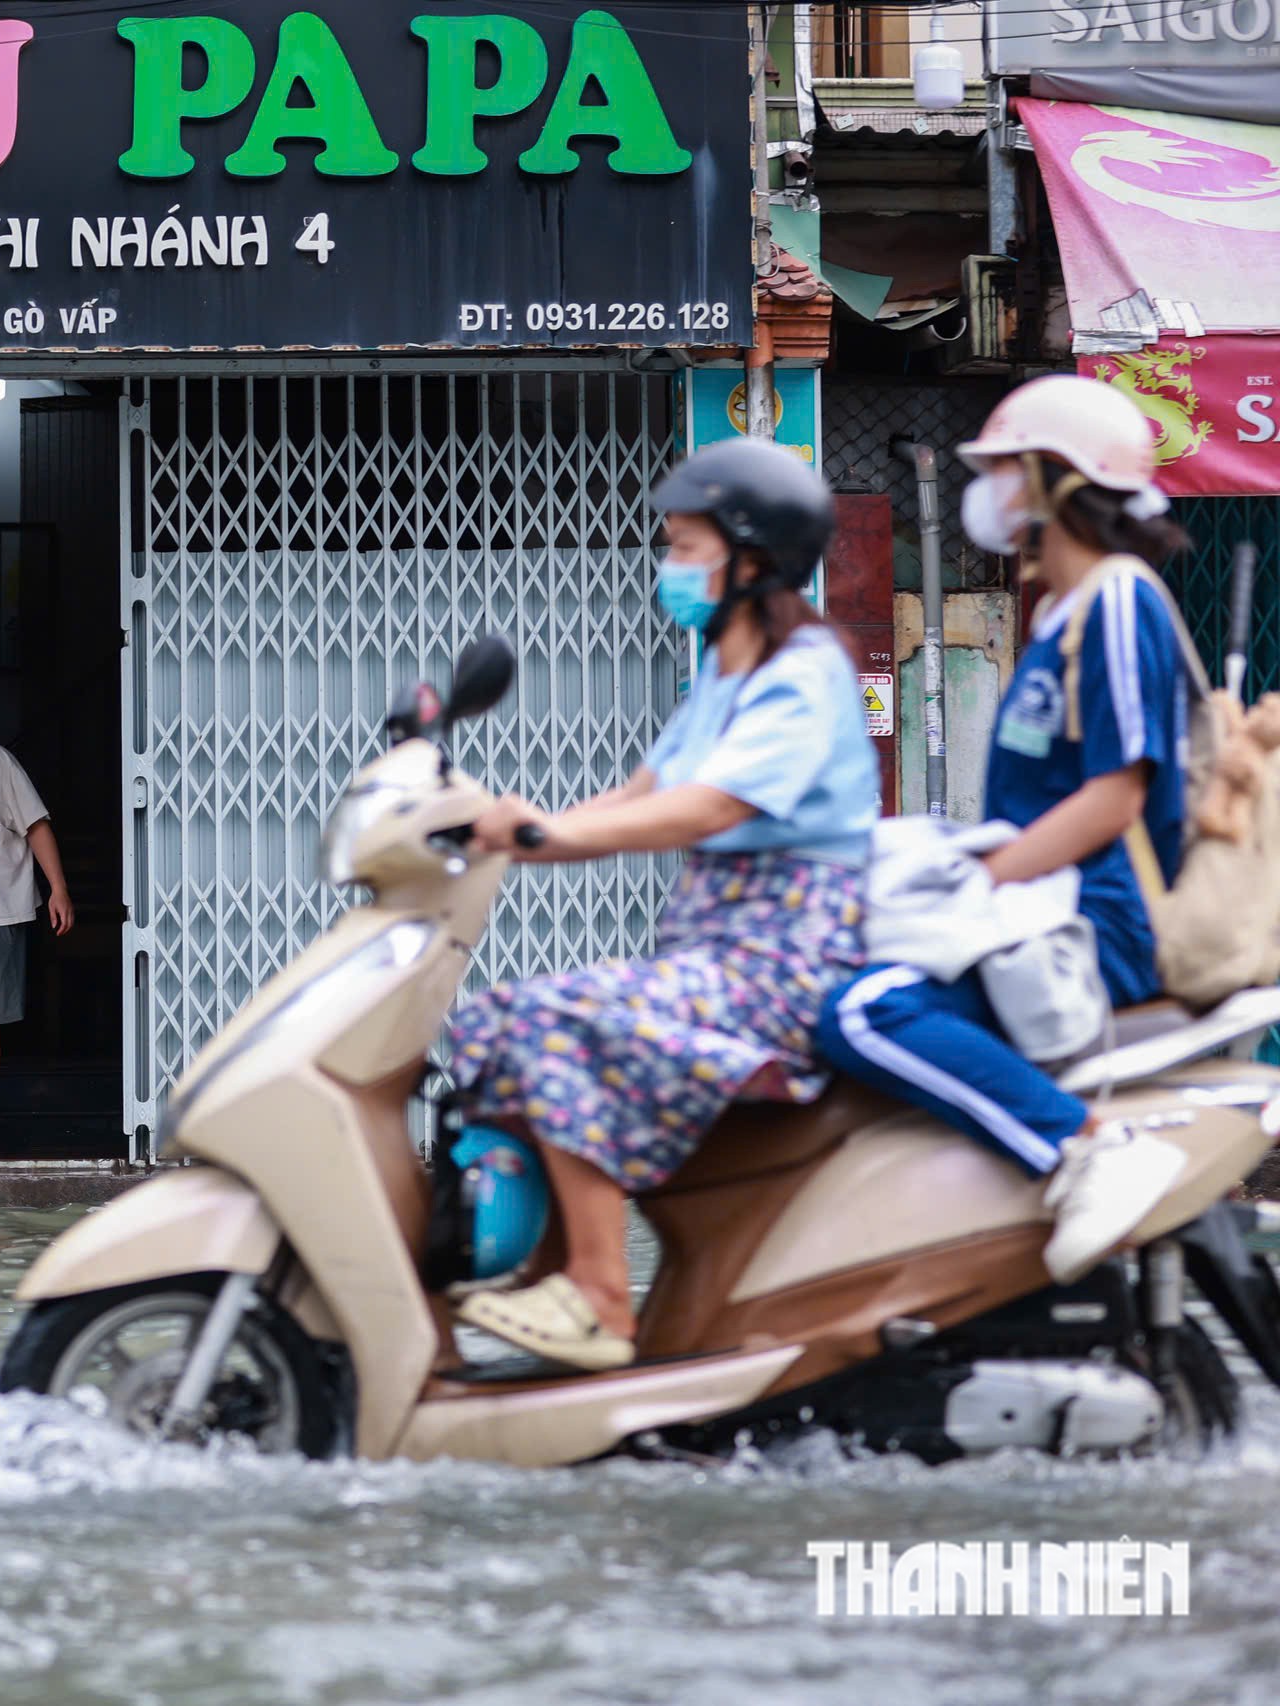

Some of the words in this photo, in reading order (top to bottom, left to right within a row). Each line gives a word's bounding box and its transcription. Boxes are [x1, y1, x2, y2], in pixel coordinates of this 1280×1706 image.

[1050, 0, 1280, 42] SAIGO
[117, 10, 693, 178] PAPA
[71, 204, 269, 267] NHÁNH
[295, 212, 336, 264] 4
[3, 300, 45, 334] GÒ
[59, 298, 118, 334] VẤP
[459, 304, 512, 331] ĐT:
[526, 302, 730, 330] 0931.226.128
[1236, 394, 1280, 443] S
